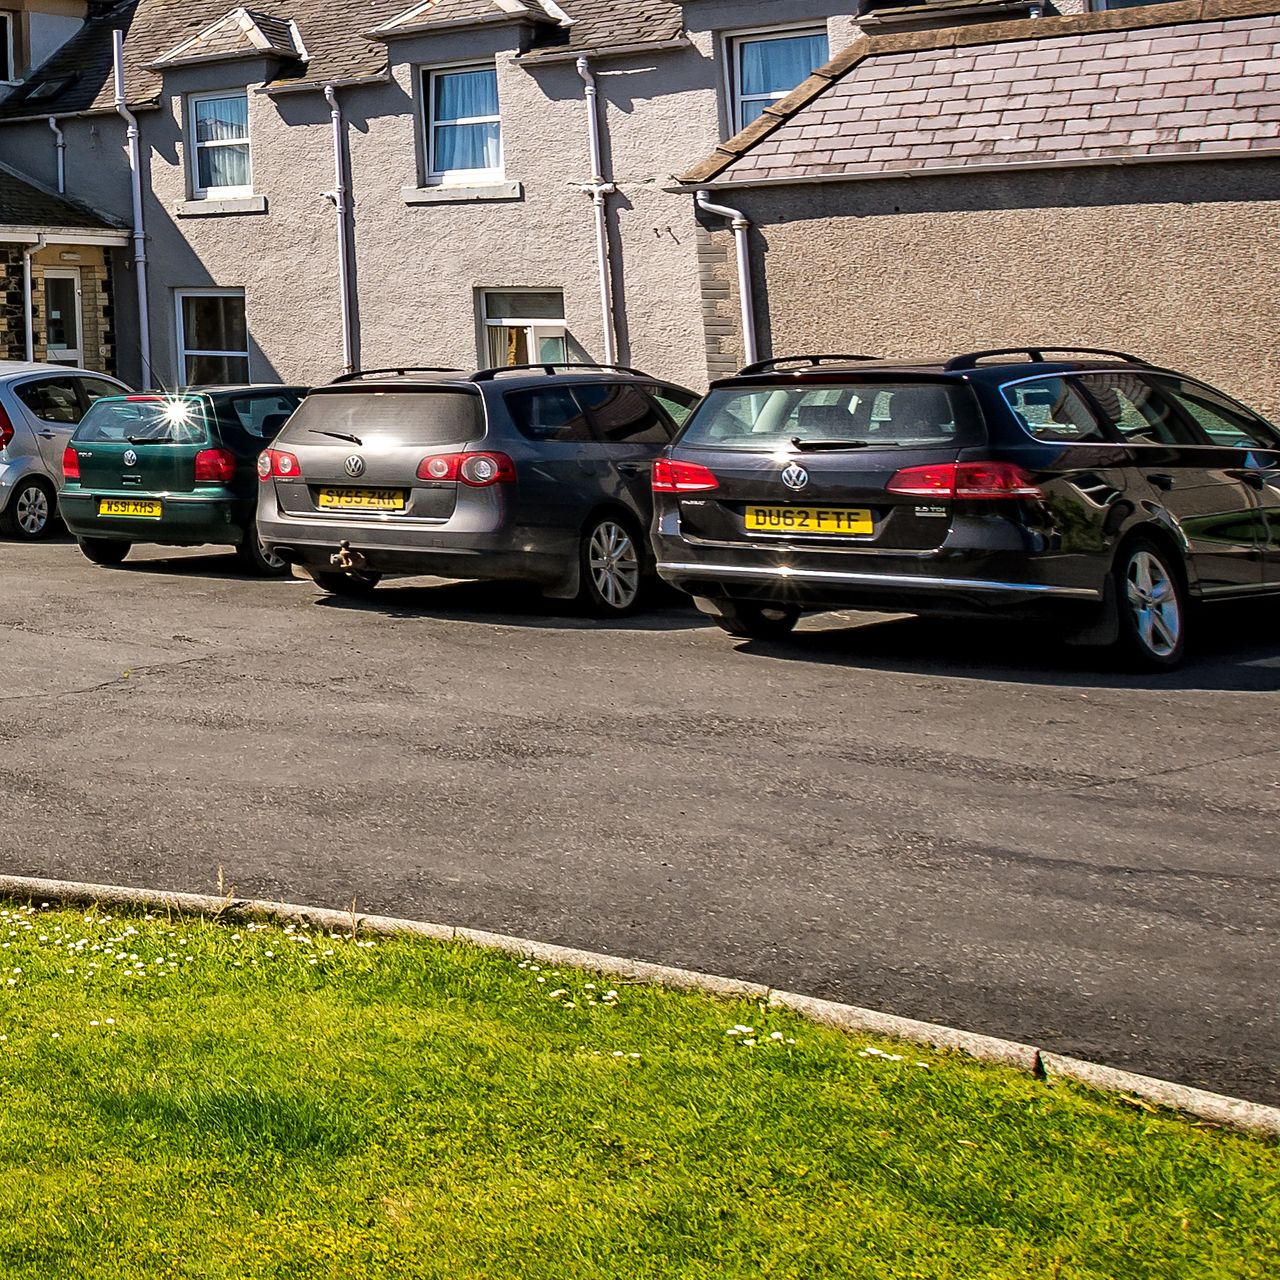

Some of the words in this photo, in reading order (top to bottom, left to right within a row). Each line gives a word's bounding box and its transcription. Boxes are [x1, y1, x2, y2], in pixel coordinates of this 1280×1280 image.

[326, 490, 363, 504] SY55
[367, 491, 396, 505] ZKK
[132, 501, 155, 513] XHS
[754, 509, 810, 527] DU62
[816, 511, 860, 529] FTF
